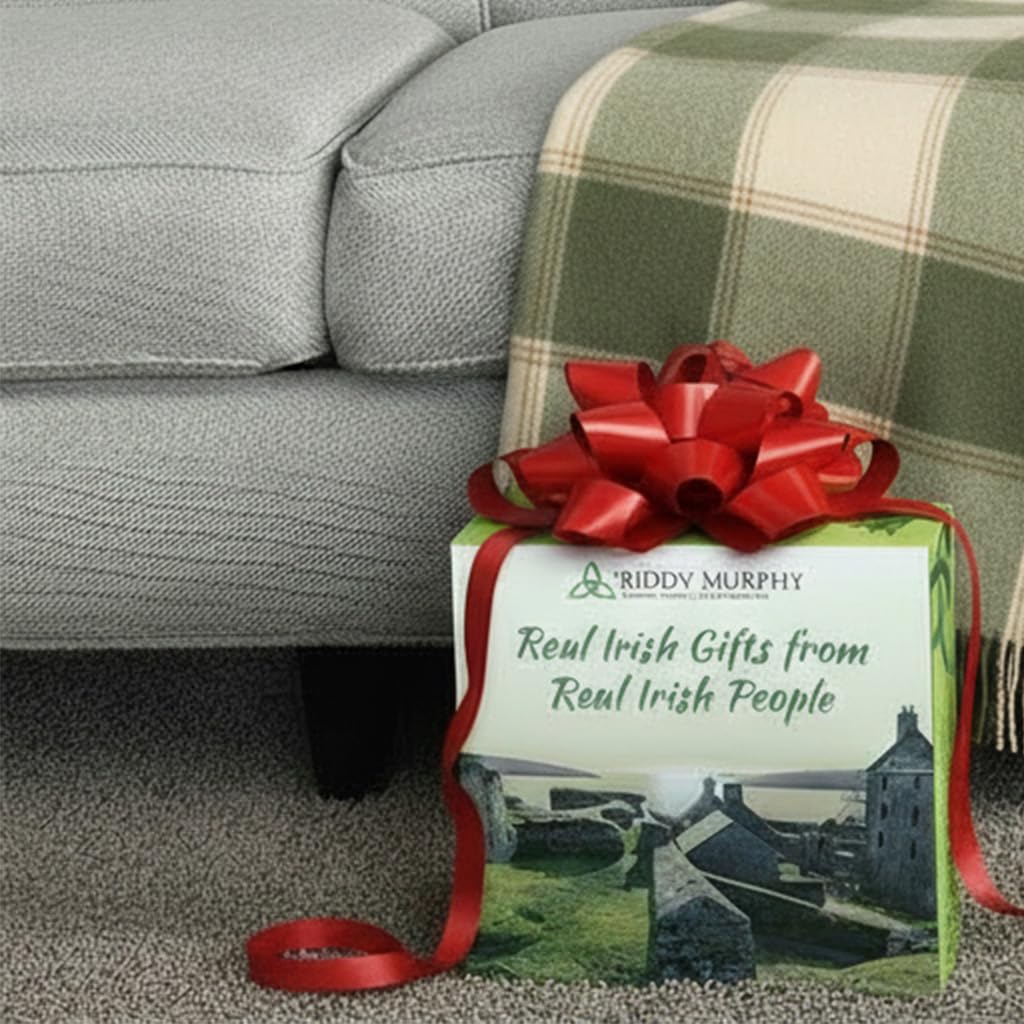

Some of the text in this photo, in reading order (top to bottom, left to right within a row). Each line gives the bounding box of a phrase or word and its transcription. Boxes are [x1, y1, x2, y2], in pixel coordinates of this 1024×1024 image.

[701, 570, 803, 591] MURPHY
[603, 626, 679, 665] Irish
[691, 627, 773, 672] Gifts
[784, 629, 870, 673] from
[638, 675, 715, 714] Irish
[728, 678, 836, 727] People
